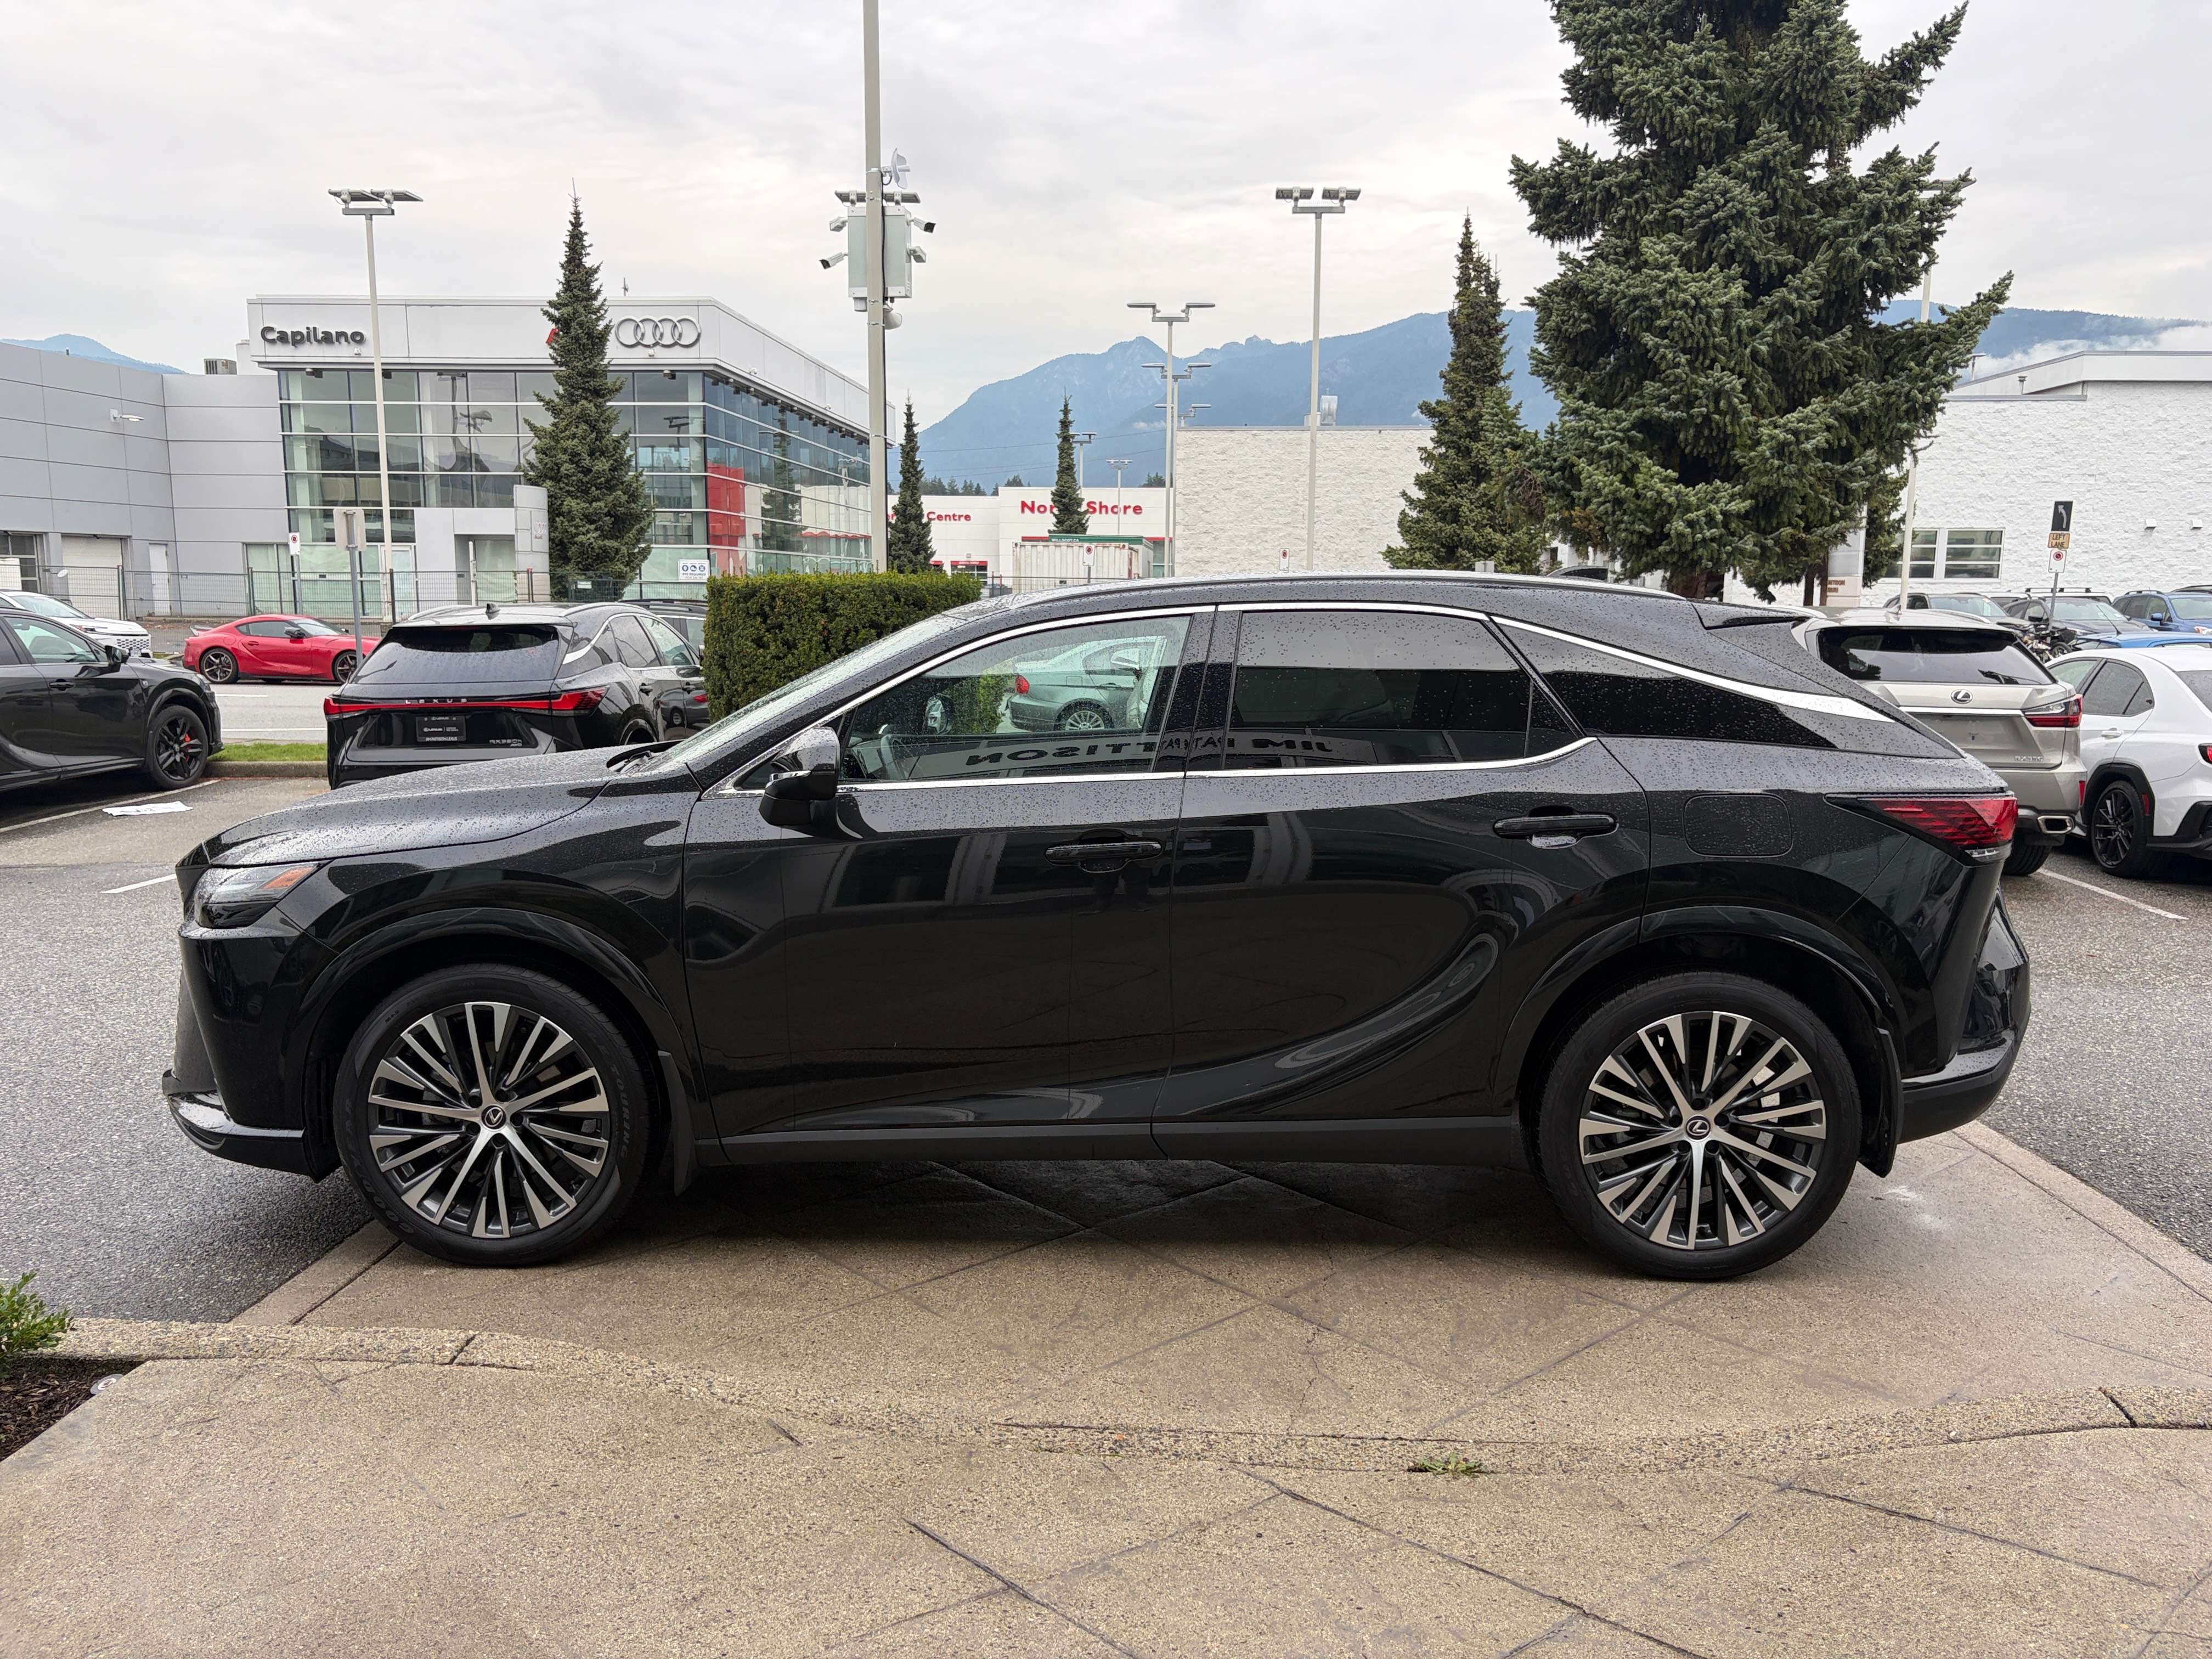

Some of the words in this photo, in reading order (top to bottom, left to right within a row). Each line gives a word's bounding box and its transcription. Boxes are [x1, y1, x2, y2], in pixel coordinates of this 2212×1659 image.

[261, 326, 366, 347] Capilano
[1020, 500, 1056, 514] Nor
[1086, 501, 1143, 515] Shore
[927, 511, 972, 522] Centre
